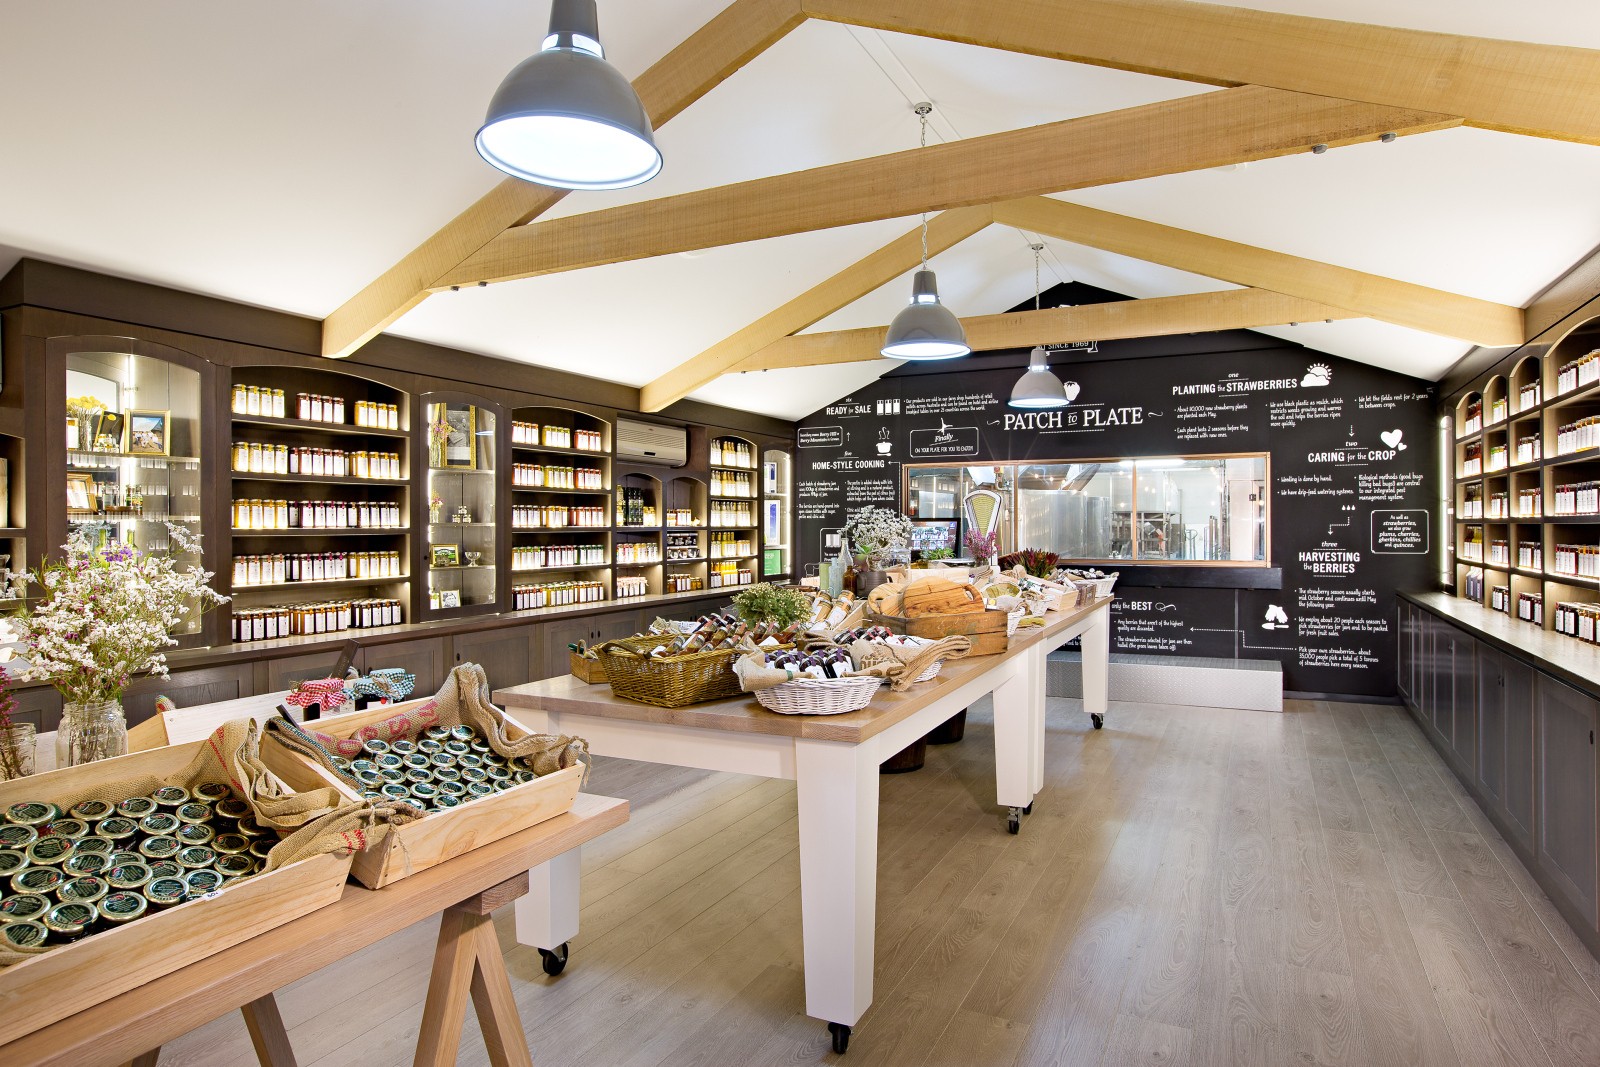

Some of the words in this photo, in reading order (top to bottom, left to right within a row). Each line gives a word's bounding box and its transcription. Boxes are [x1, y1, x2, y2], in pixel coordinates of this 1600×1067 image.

[1172, 384, 1216, 395] PLANTING
[1217, 384, 1226, 392] the
[1226, 378, 1297, 392] STRAWBERRIES
[1380, 395, 1393, 403] fields
[826, 406, 847, 415] READY
[854, 405, 872, 414] SALE
[1004, 412, 1062, 431] PATCH
[1068, 413, 1078, 422] to
[1083, 407, 1143, 426] PLATE
[935, 432, 953, 442] Finally
[1308, 451, 1345, 463] CARING
[1347, 452, 1356, 462] for
[1368, 450, 1396, 461] CROP
[812, 461, 853, 470] HOME-STYLE
[855, 460, 885, 468] COOKING
[1359, 474, 1378, 482] Biological
[1398, 473, 1412, 481] (good
[1412, 473, 1424, 481] bugs
[1299, 552, 1360, 562] HARVESTING
[1303, 562, 1312, 570] the
[1313, 563, 1355, 573] BERRIES
[1307, 588, 1330, 596] strawberry
[1345, 589, 1361, 597] usually
[1112, 602, 1122, 610] only
[1131, 602, 1152, 610] BEST
[1306, 601, 1325, 610] following
[1305, 616, 1320, 624] employ
[1341, 617, 1354, 625] people
[1373, 625, 1388, 633] packed
